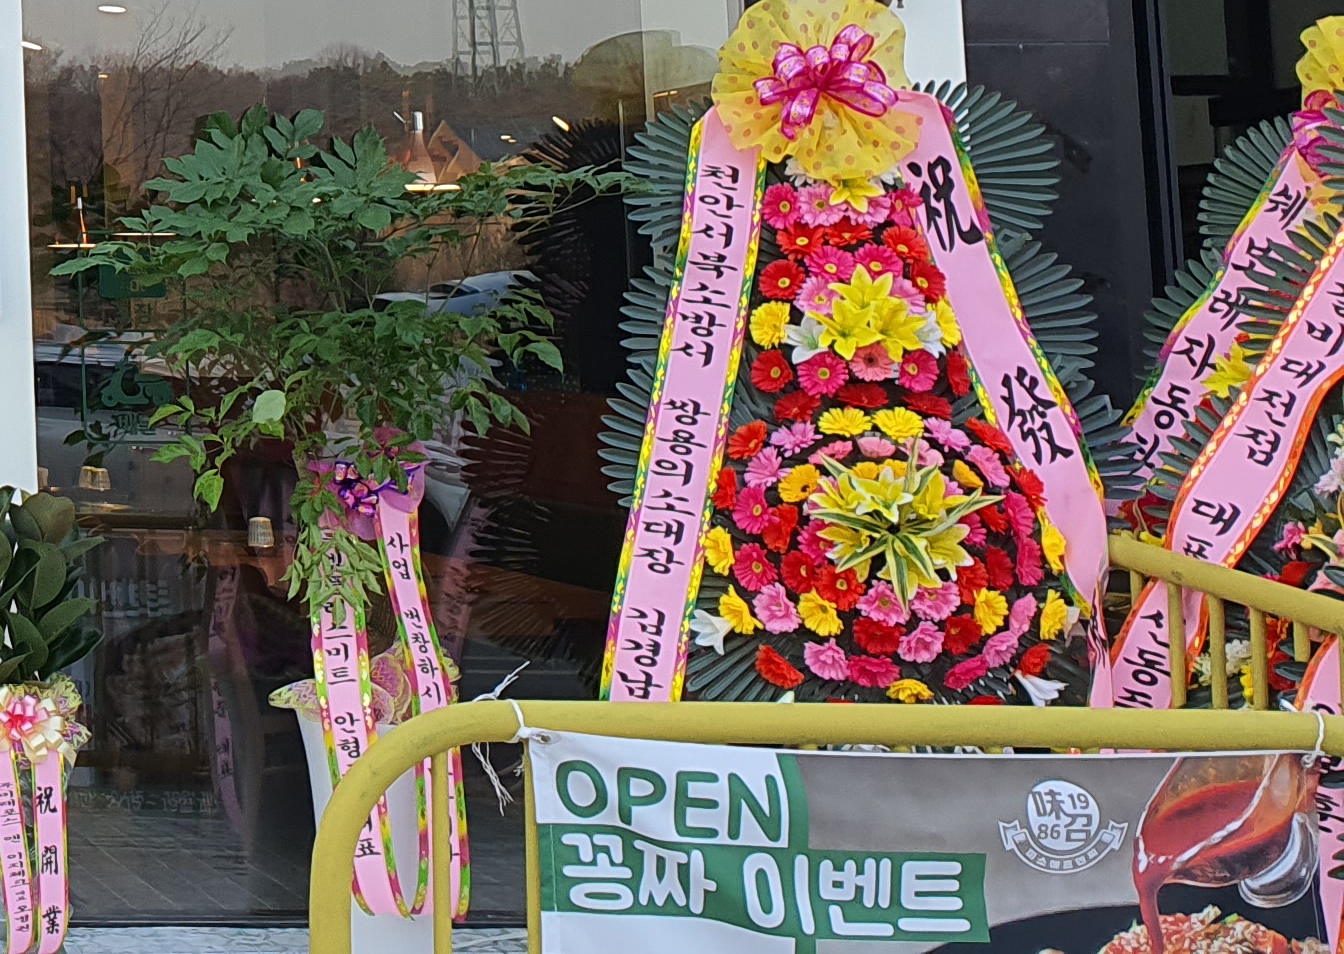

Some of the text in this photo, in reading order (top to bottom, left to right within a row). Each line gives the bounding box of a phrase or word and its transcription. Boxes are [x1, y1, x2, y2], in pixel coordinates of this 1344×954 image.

[670, 163, 745, 369] 천안서북소방서
[386, 532, 412, 581] 사업
[615, 606, 665, 701] 김경남
[553, 759, 784, 843] OPEN
[1036, 823, 1062, 841] 86
[1066, 792, 1090, 810] 19
[558, 832, 971, 939] 꽁짜 이벤트
